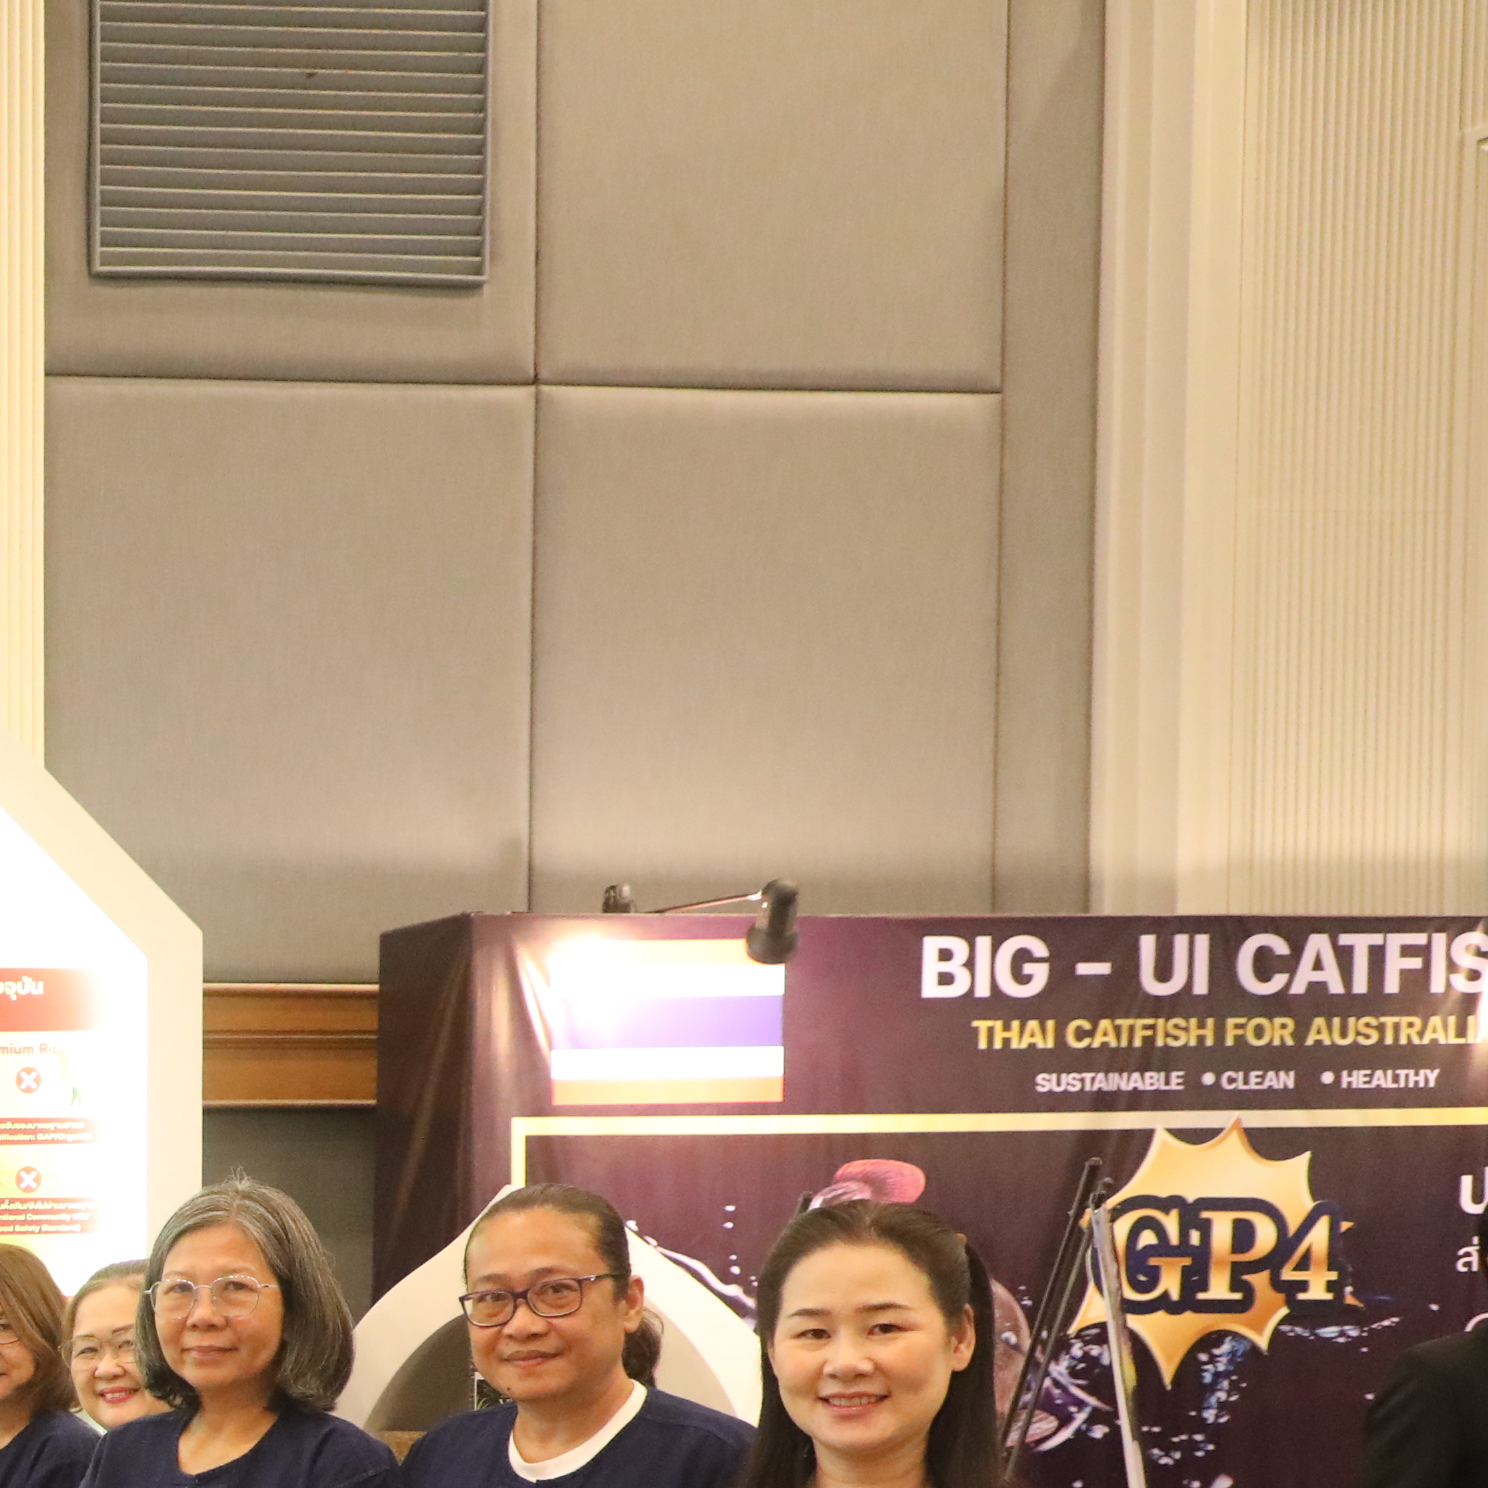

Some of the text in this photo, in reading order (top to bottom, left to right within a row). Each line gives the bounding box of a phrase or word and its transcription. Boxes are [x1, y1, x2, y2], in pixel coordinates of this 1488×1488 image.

[920, 934, 1051, 999] BIG
[1138, 932, 1211, 997] UI
[971, 1019, 1057, 1050] THAI
[1066, 1017, 1216, 1049] CATFISH
[1225, 1016, 1295, 1048] FOR
[1034, 1068, 1440, 1093] SUSTAINABLE CLEAN HEALTHY
[1110, 1204, 1343, 1306] GP4
